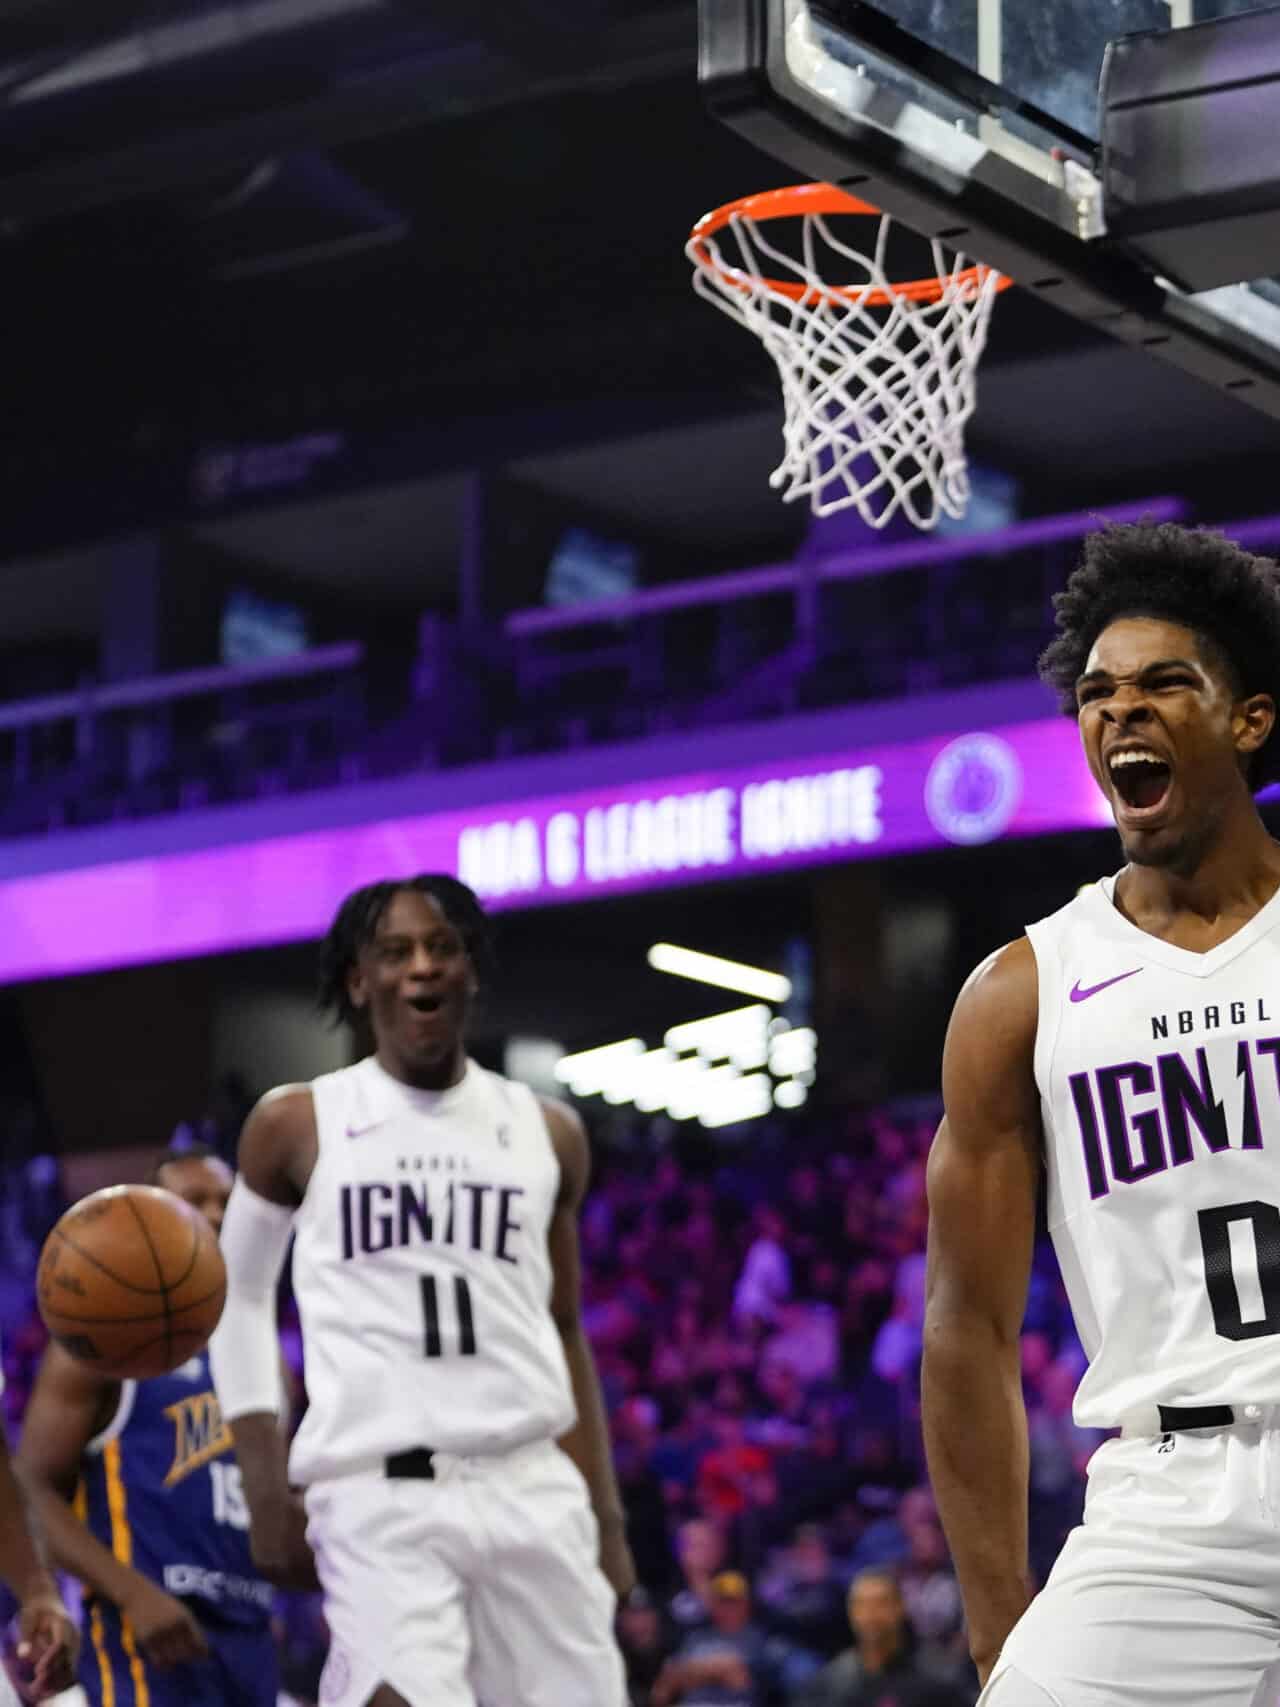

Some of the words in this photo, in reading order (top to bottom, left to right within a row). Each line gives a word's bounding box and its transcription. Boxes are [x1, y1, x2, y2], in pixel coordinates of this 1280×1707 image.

[1151, 999, 1271, 1039] NBAGL
[340, 1182, 524, 1264] IGNITE
[418, 1274, 477, 1357] 11
